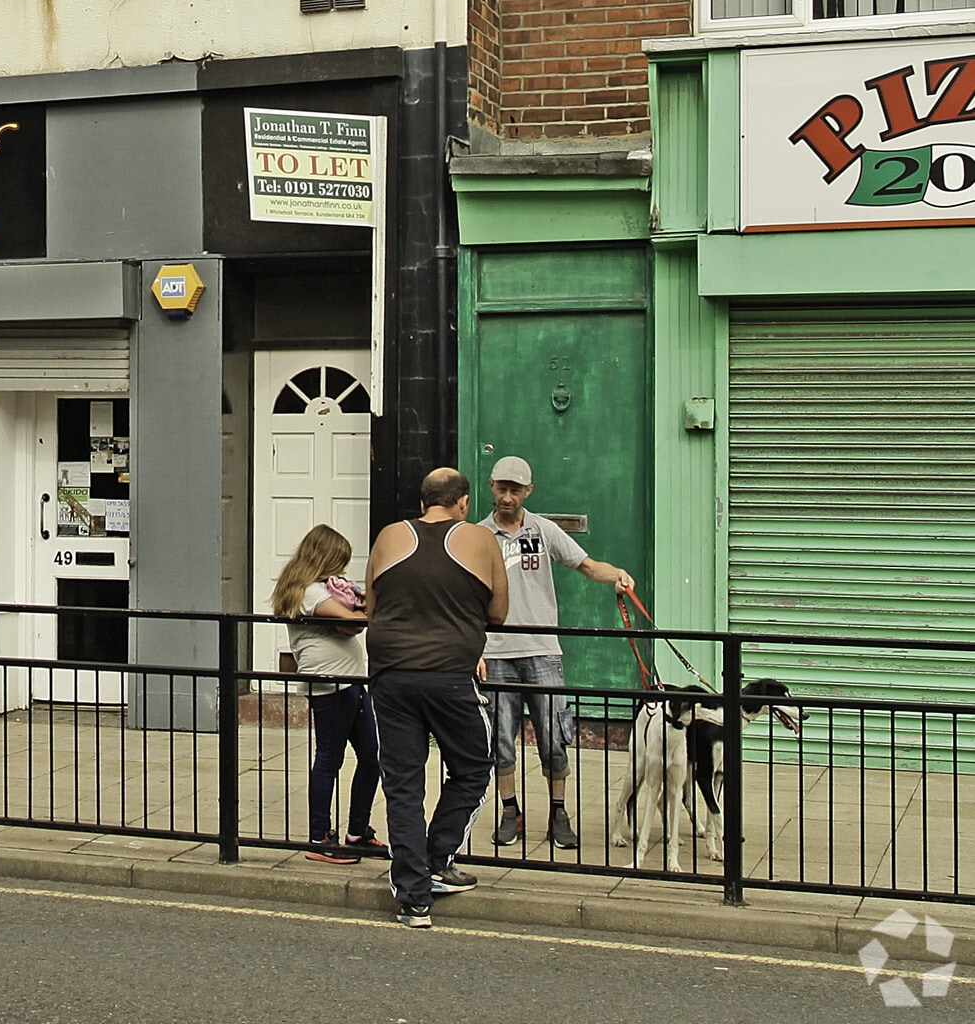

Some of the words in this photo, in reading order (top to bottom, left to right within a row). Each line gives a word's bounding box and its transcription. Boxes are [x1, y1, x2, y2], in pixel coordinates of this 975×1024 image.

[254, 116, 316, 134] Jonathan
[319, 120, 333, 135] T.
[336, 122, 367, 138] Finn
[254, 133, 287, 141] Residential
[292, 136, 329, 144] Commercial
[329, 137, 347, 145] Estate
[347, 139, 367, 147] Agents
[256, 152, 299, 174] TO
[308, 155, 369, 178] LET
[257, 179, 282, 193] Tel:
[284, 180, 314, 195] 0191
[318, 182, 370, 199] 5277030
[162, 281, 185, 294] ADT
[54, 551, 73, 566] 49
[521, 554, 540, 571] 88
